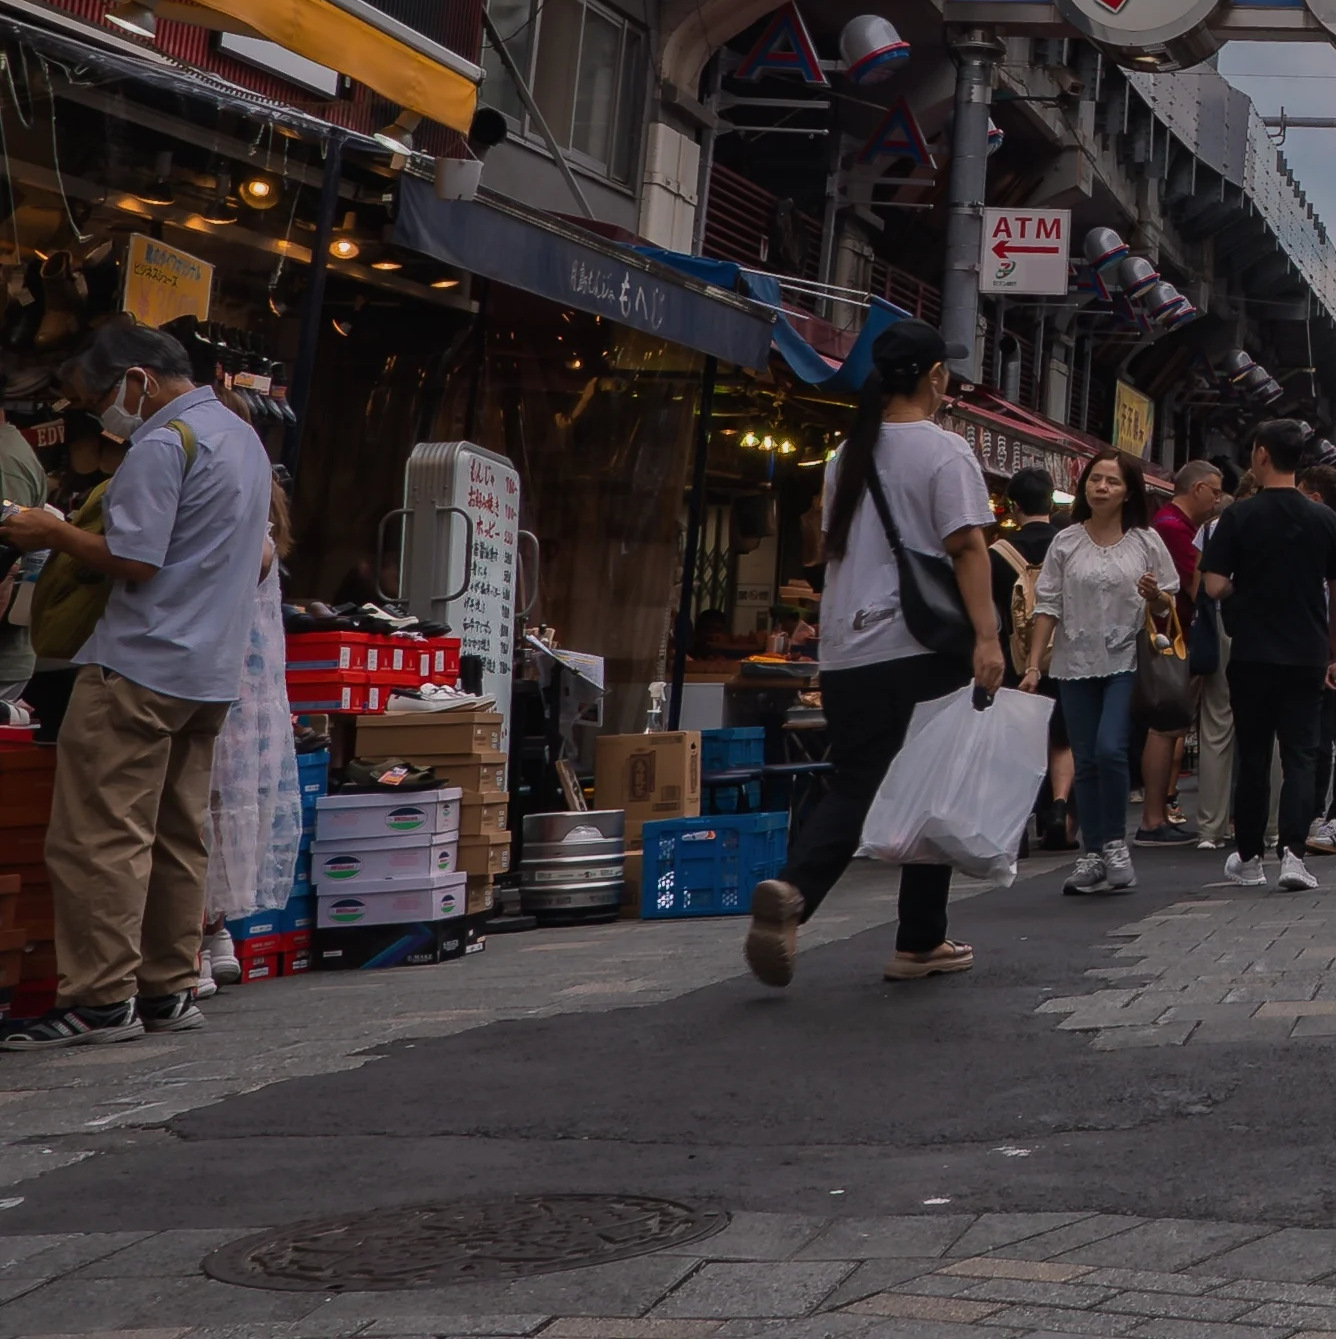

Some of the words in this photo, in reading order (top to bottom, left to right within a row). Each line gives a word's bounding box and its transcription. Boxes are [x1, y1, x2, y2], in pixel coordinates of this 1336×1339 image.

[992, 217, 1061, 239] ATM
[619, 271, 665, 331] もへじ
